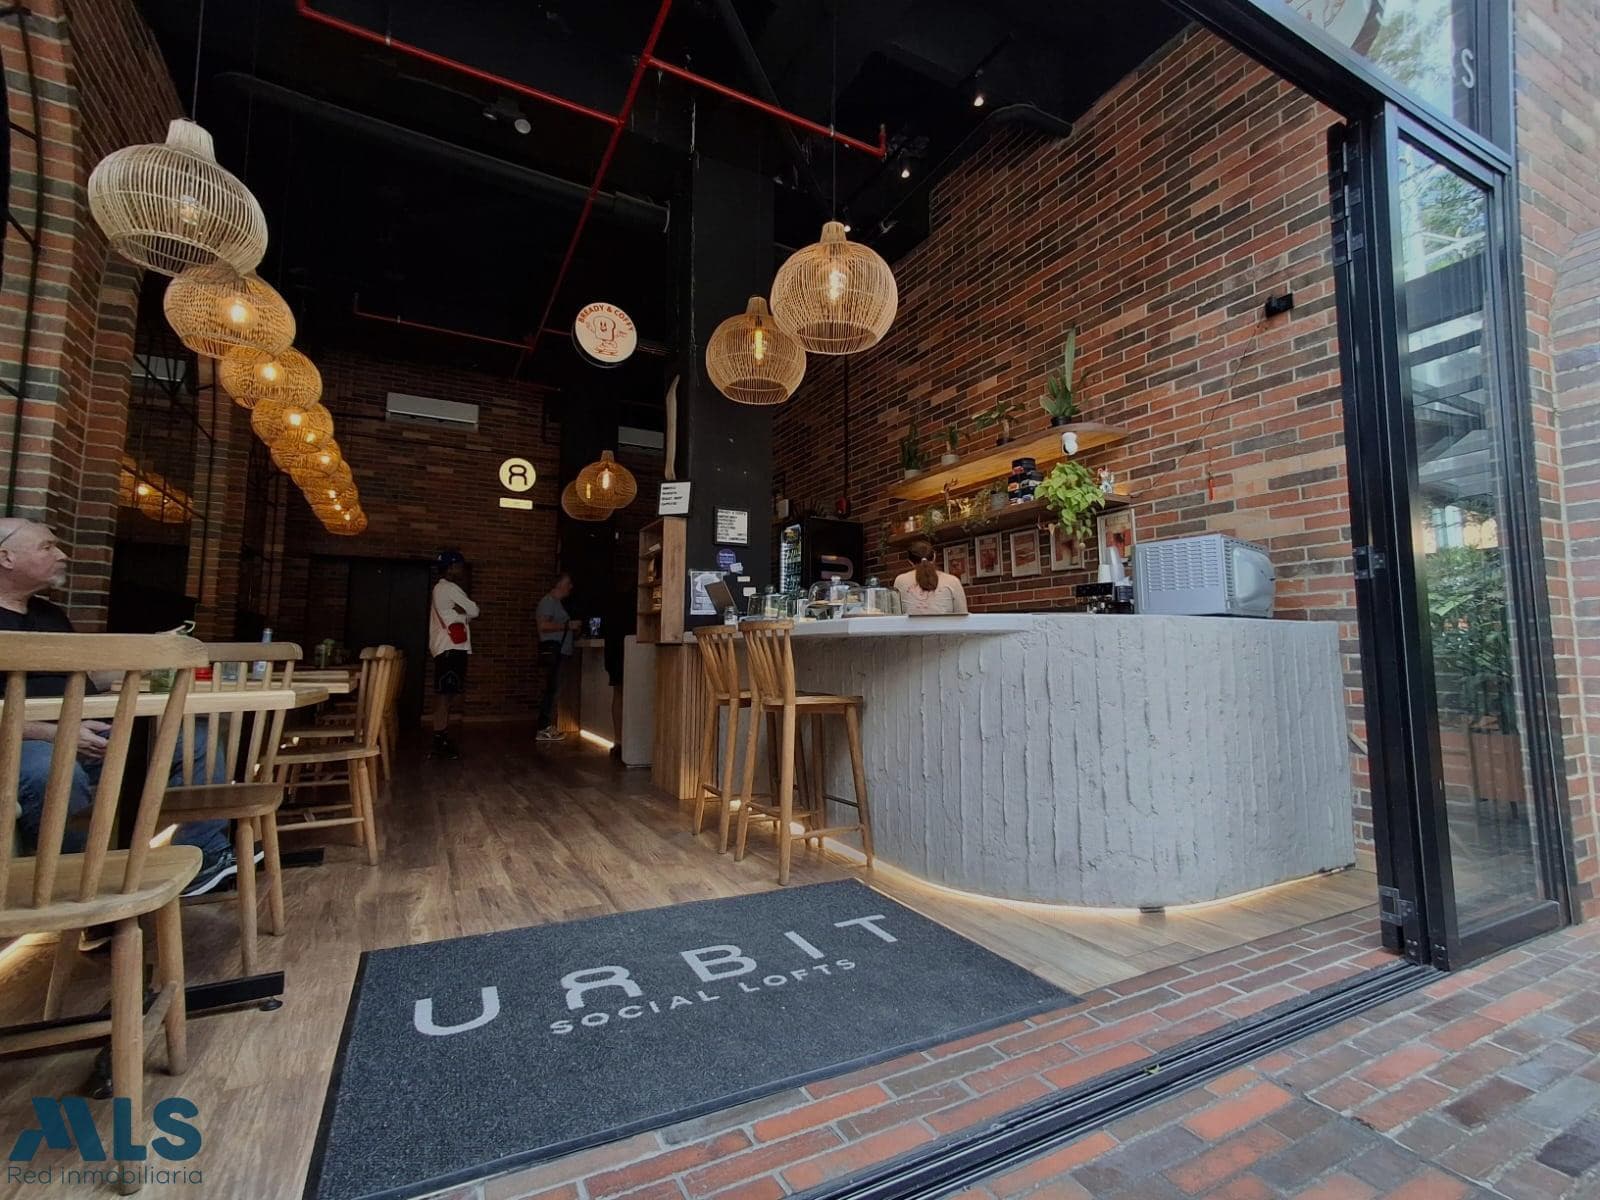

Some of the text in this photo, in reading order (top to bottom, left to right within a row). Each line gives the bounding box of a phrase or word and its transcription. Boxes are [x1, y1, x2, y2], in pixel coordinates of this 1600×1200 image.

[578, 304, 605, 324] BREADY
[414, 914, 898, 1036] URBIT
[550, 958, 856, 1035] SOCIAL LOFTS
